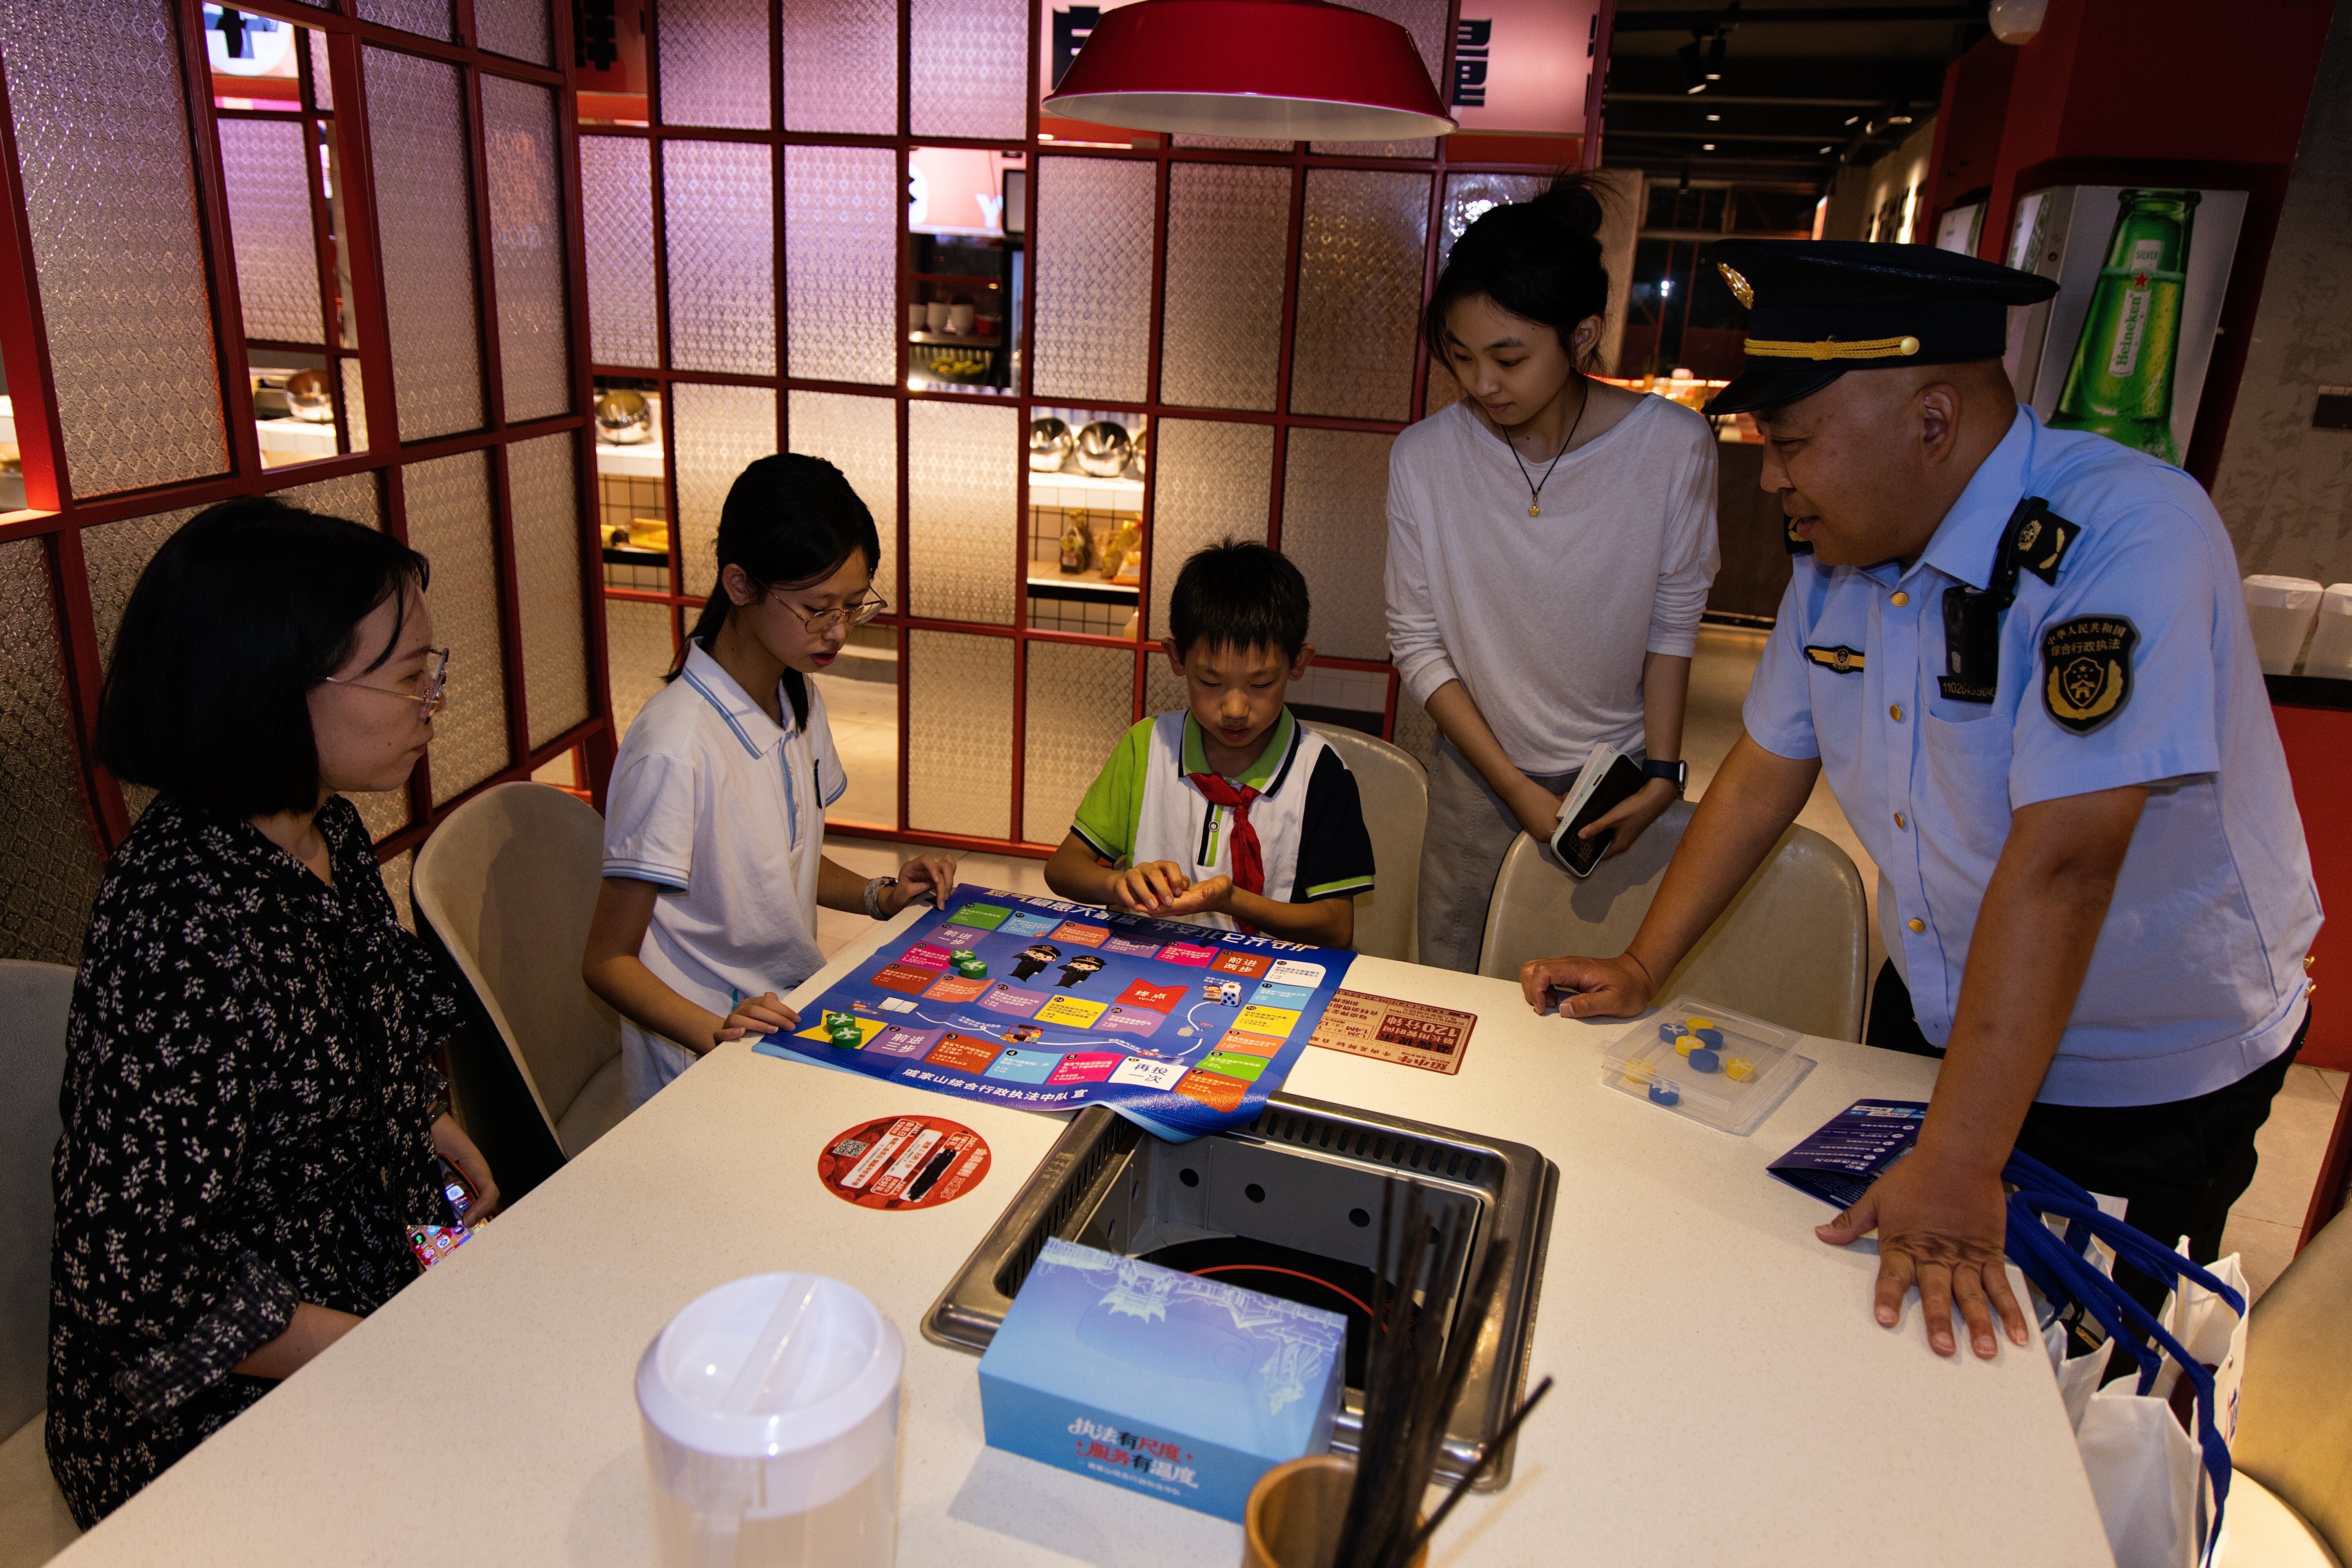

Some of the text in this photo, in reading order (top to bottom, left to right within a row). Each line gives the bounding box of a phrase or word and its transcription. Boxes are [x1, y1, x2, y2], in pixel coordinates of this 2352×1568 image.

[2116, 296, 2143, 367] Heineken
[2047, 622, 2126, 646] 中华人民共和国
[2051, 637, 2121, 657] 综合行政执法
[983, 888, 1143, 926] 燃气隐患大家查
[1152, 920, 1321, 953] 平安北仑齐守护
[938, 936, 965, 946] 一步
[943, 929, 973, 940] 前进
[1223, 962, 1253, 973] 两步
[1227, 956, 1258, 967] 前进
[1133, 990, 1167, 1000] 终点
[1382, 1025, 1455, 1045] 最长用餐时间
[1385, 1015, 1459, 1038] 120分钟
[882, 1041, 916, 1053] 三步
[891, 1033, 925, 1044] 前进
[1377, 1032, 1452, 1054] 温馨提示
[1335, 1041, 1391, 1057] 牛肉是鲜切
[1134, 1063, 1169, 1074] 再投
[902, 1068, 1088, 1102] 戚家山综合行政执法中队 宣
[1128, 1073, 1163, 1084] 一次
[896, 1120, 916, 1138] 会员日
[875, 1137, 900, 1159] 每周二会员日
[963, 1137, 978, 1151] PART.1
[1067, 1417, 1182, 1464] 执法有尺度
[1076, 1441, 1199, 1489] 服务有温度
